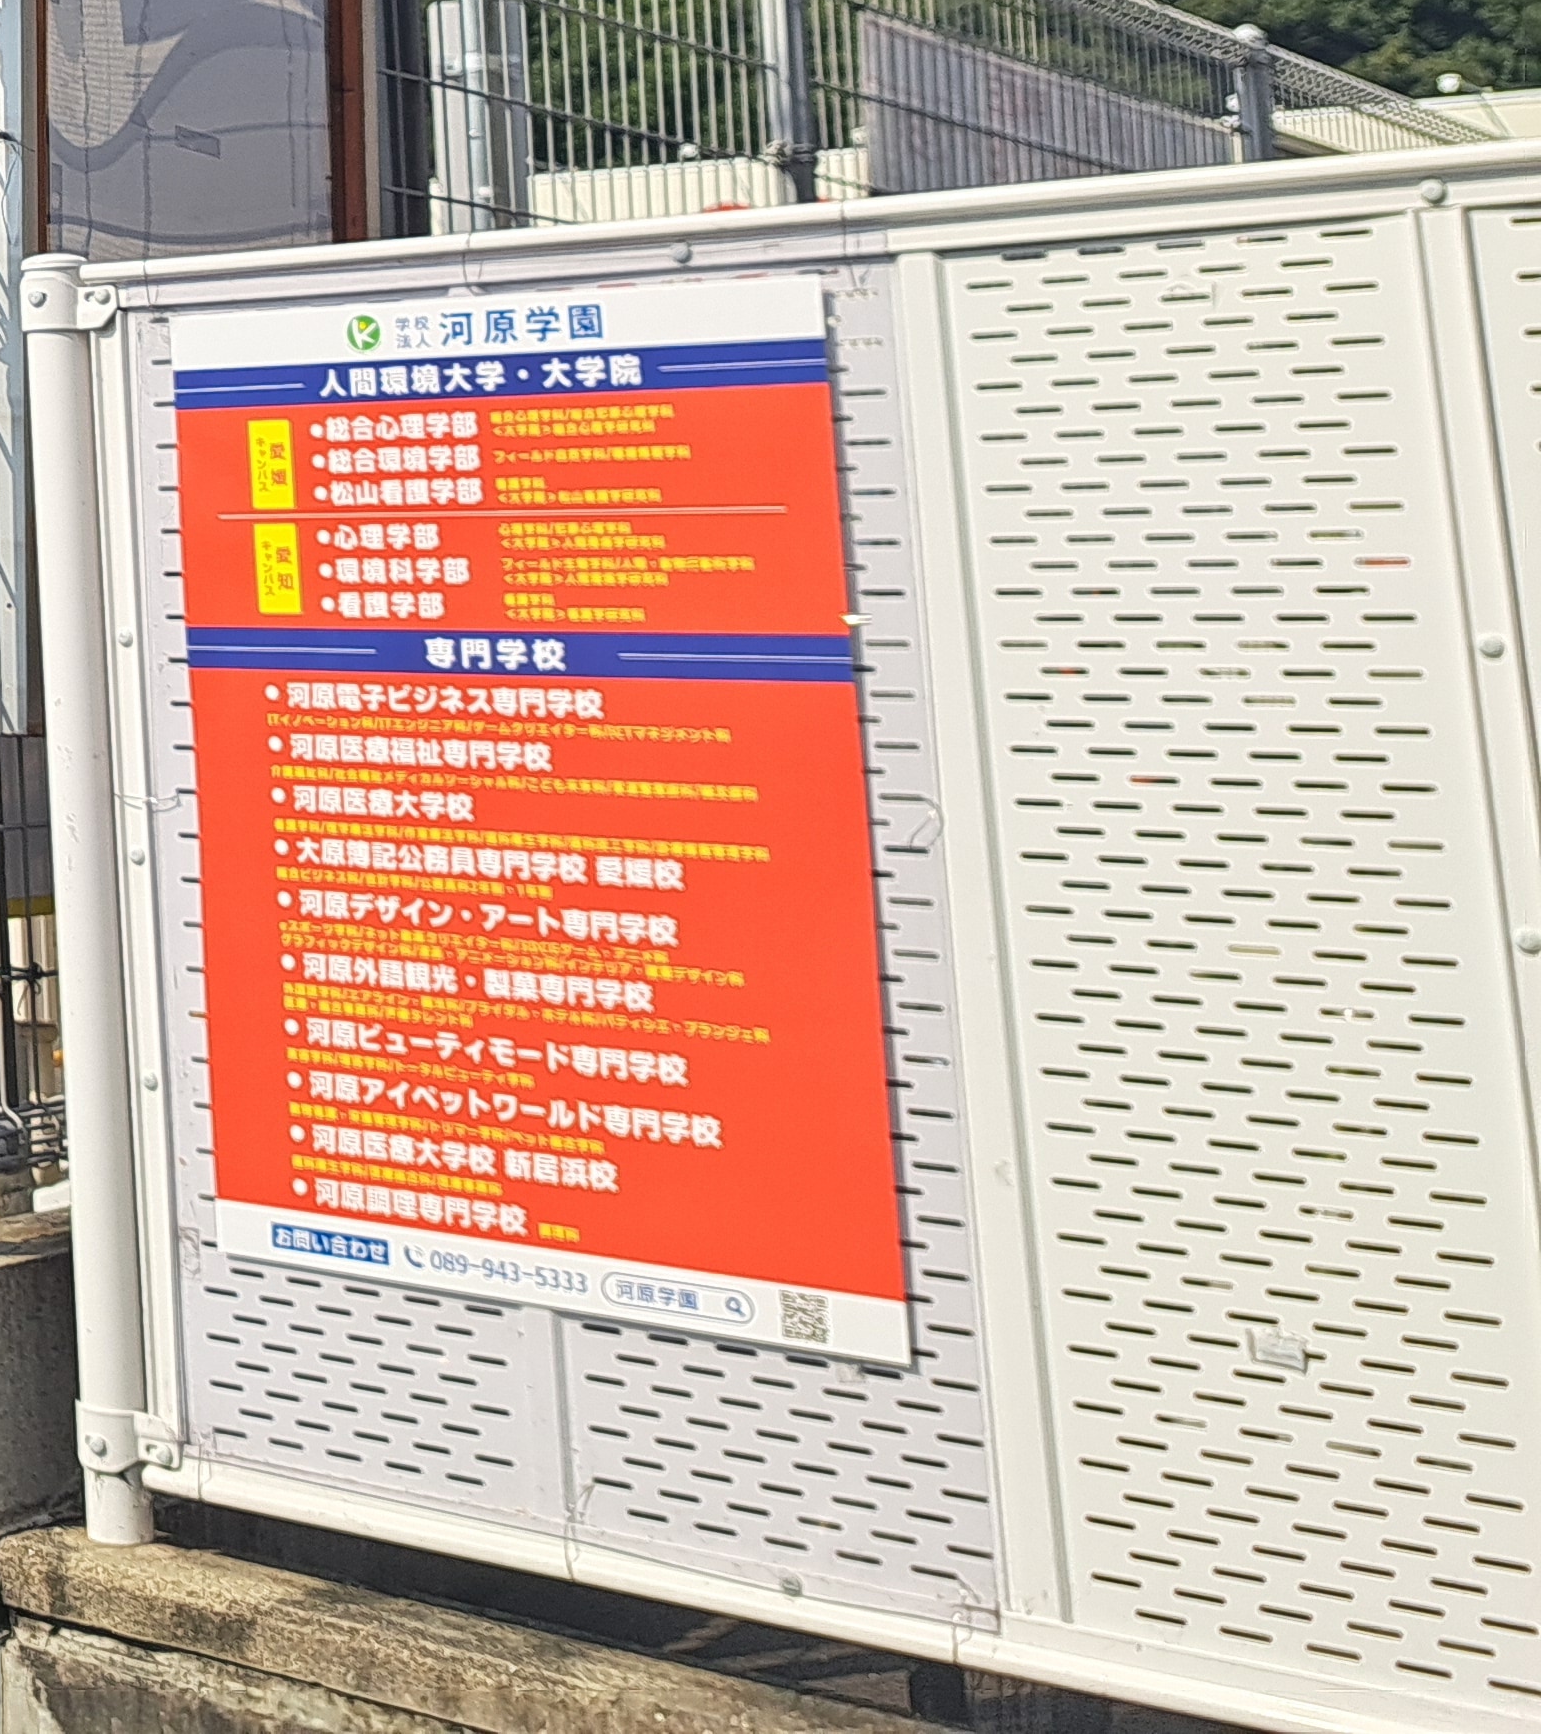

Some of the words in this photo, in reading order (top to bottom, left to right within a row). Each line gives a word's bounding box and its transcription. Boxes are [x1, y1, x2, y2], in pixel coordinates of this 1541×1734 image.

[439, 304, 604, 347] 河原学園
[320, 354, 644, 398] 人間環境大学・大学院
[326, 411, 478, 443] 総合心理学部
[334, 522, 439, 551] 心理学部
[424, 637, 566, 671] 専門学校
[286, 681, 605, 720] 河原電子ビジネス専門学校
[290, 732, 553, 773] 河原医療福祉専門学校
[293, 784, 476, 822] 河原医療大学校
[298, 888, 680, 948] 河原デザイン・アート専門学校
[306, 1017, 691, 1088] 河原ビューティモード専門学校
[309, 1070, 724, 1150] 河原アイペットワールド専門学校
[311, 1123, 498, 1177] 河原医療大学校
[314, 1177, 529, 1237] 河原調理専門学校
[275, 1224, 388, 1262] お問い合わせ
[430, 1250, 589, 1294] 089-943-5333
[616, 1279, 700, 1311] 河原学園
